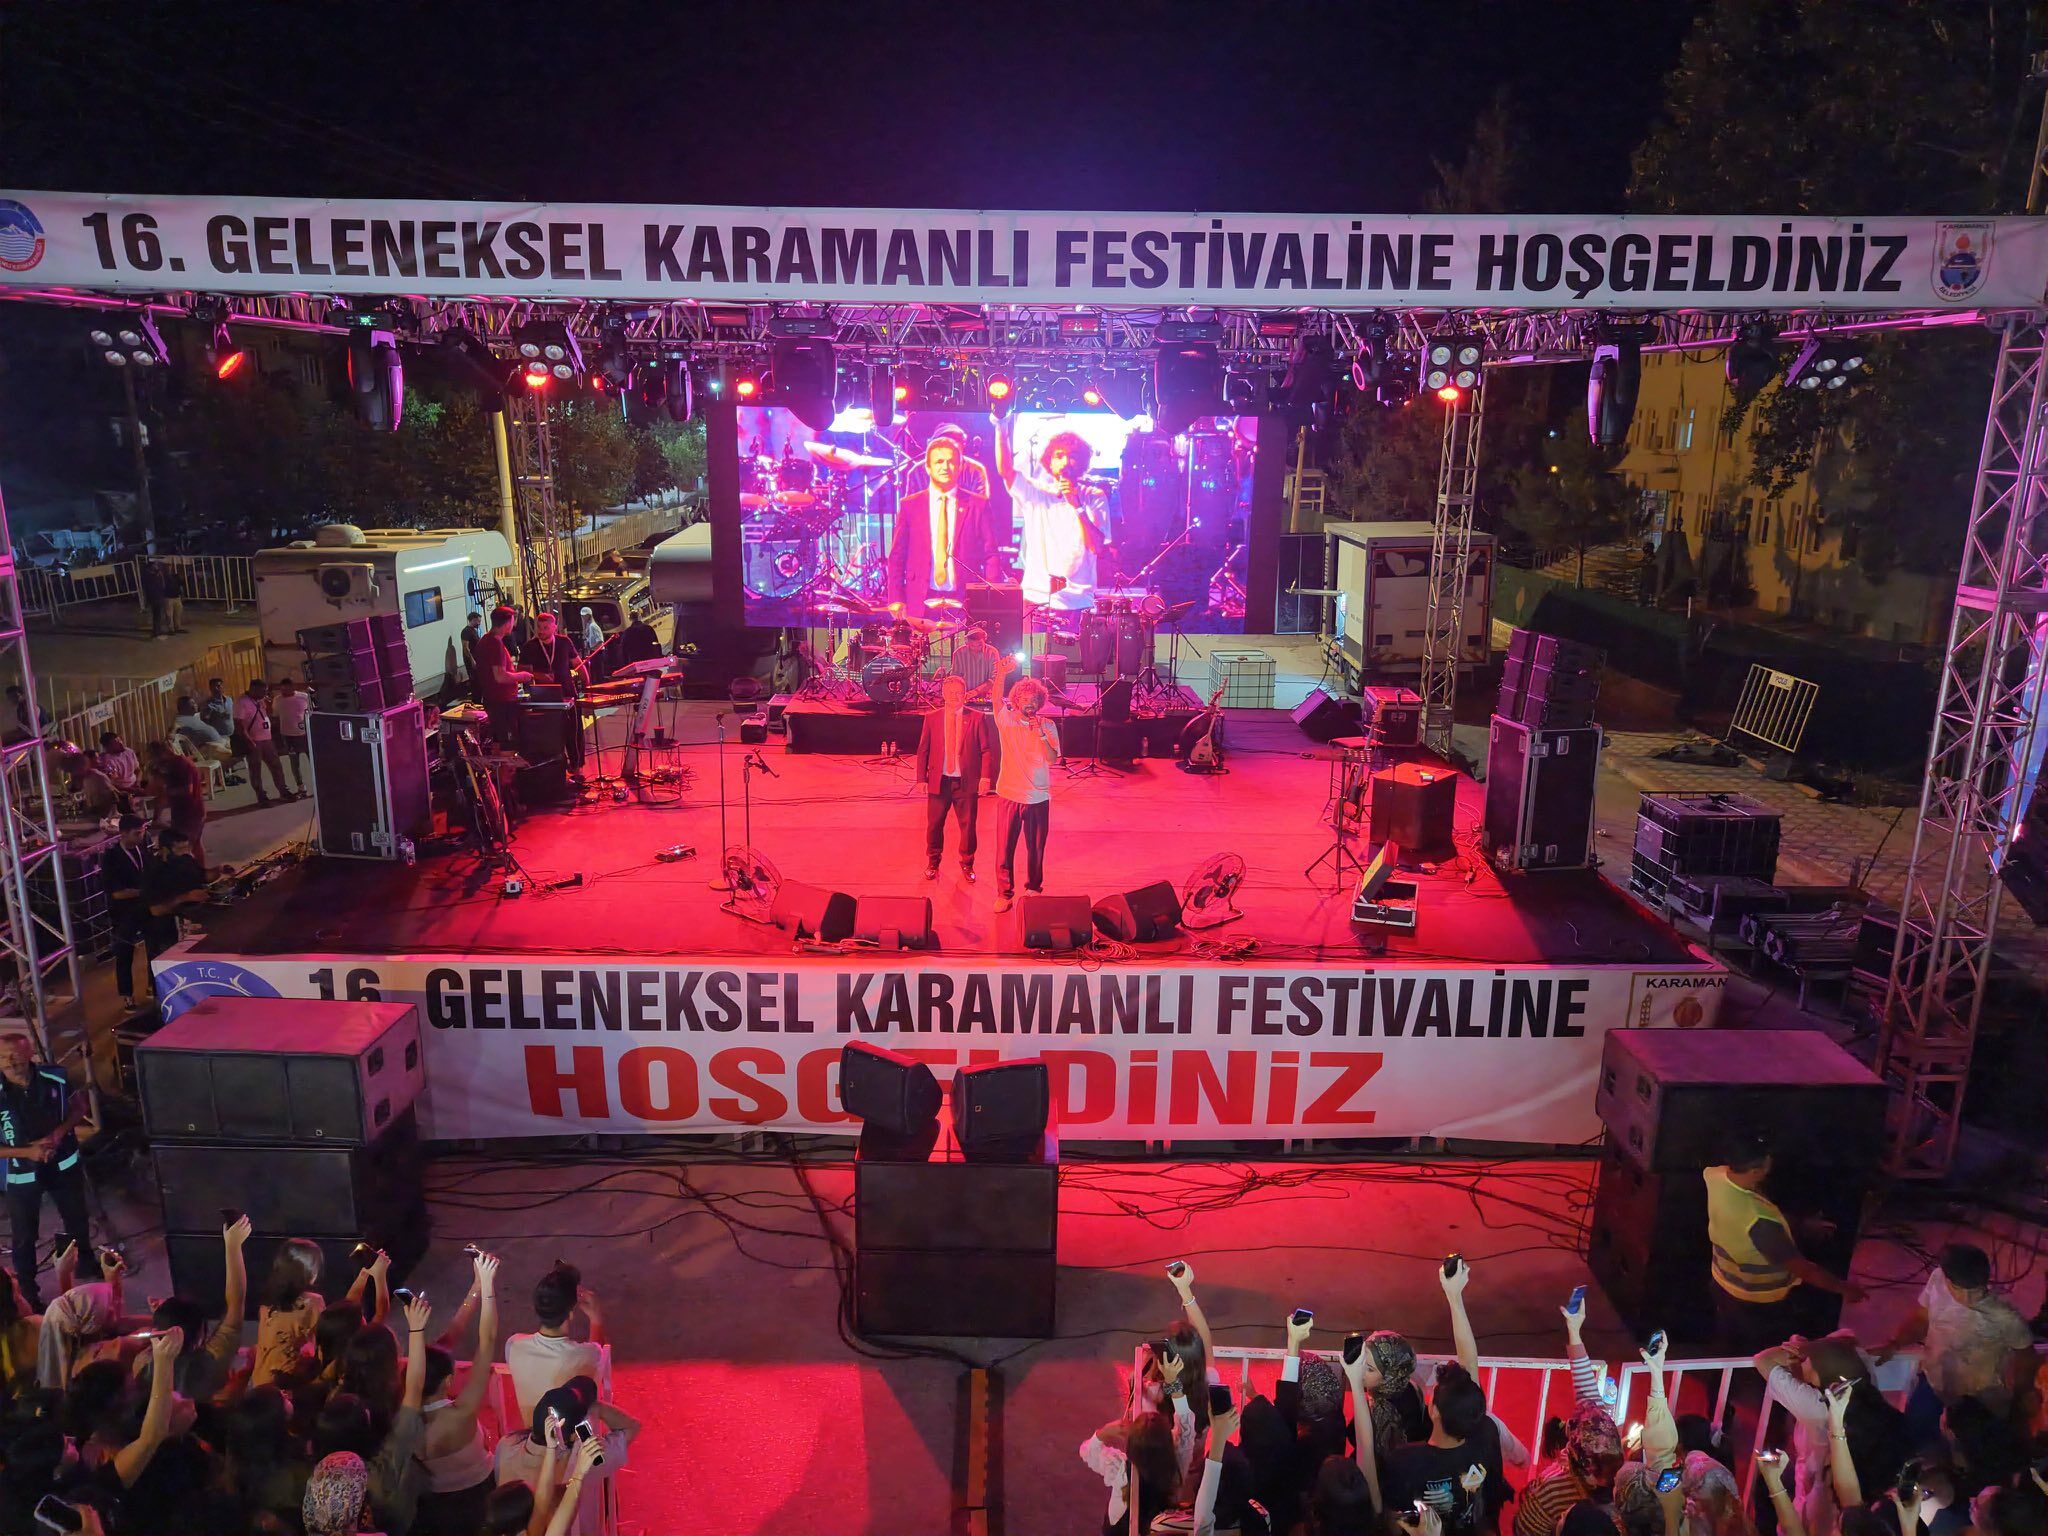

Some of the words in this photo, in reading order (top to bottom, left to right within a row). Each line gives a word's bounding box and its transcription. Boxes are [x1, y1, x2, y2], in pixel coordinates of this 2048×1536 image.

[83, 212, 185, 272] 16.
[207, 214, 622, 280] GELENEKSEL
[644, 222, 1028, 287] KARAMANLI
[1055, 219, 1454, 291] FESTİVALİNE
[1476, 222, 1908, 300] HOŞGELDİNİZ
[196, 967, 220, 979] T.C.
[425, 968, 814, 1033] GELENEKSEL
[837, 972, 1193, 1035] KARAMANLI
[1216, 968, 1589, 1037] FESTİVALİNE
